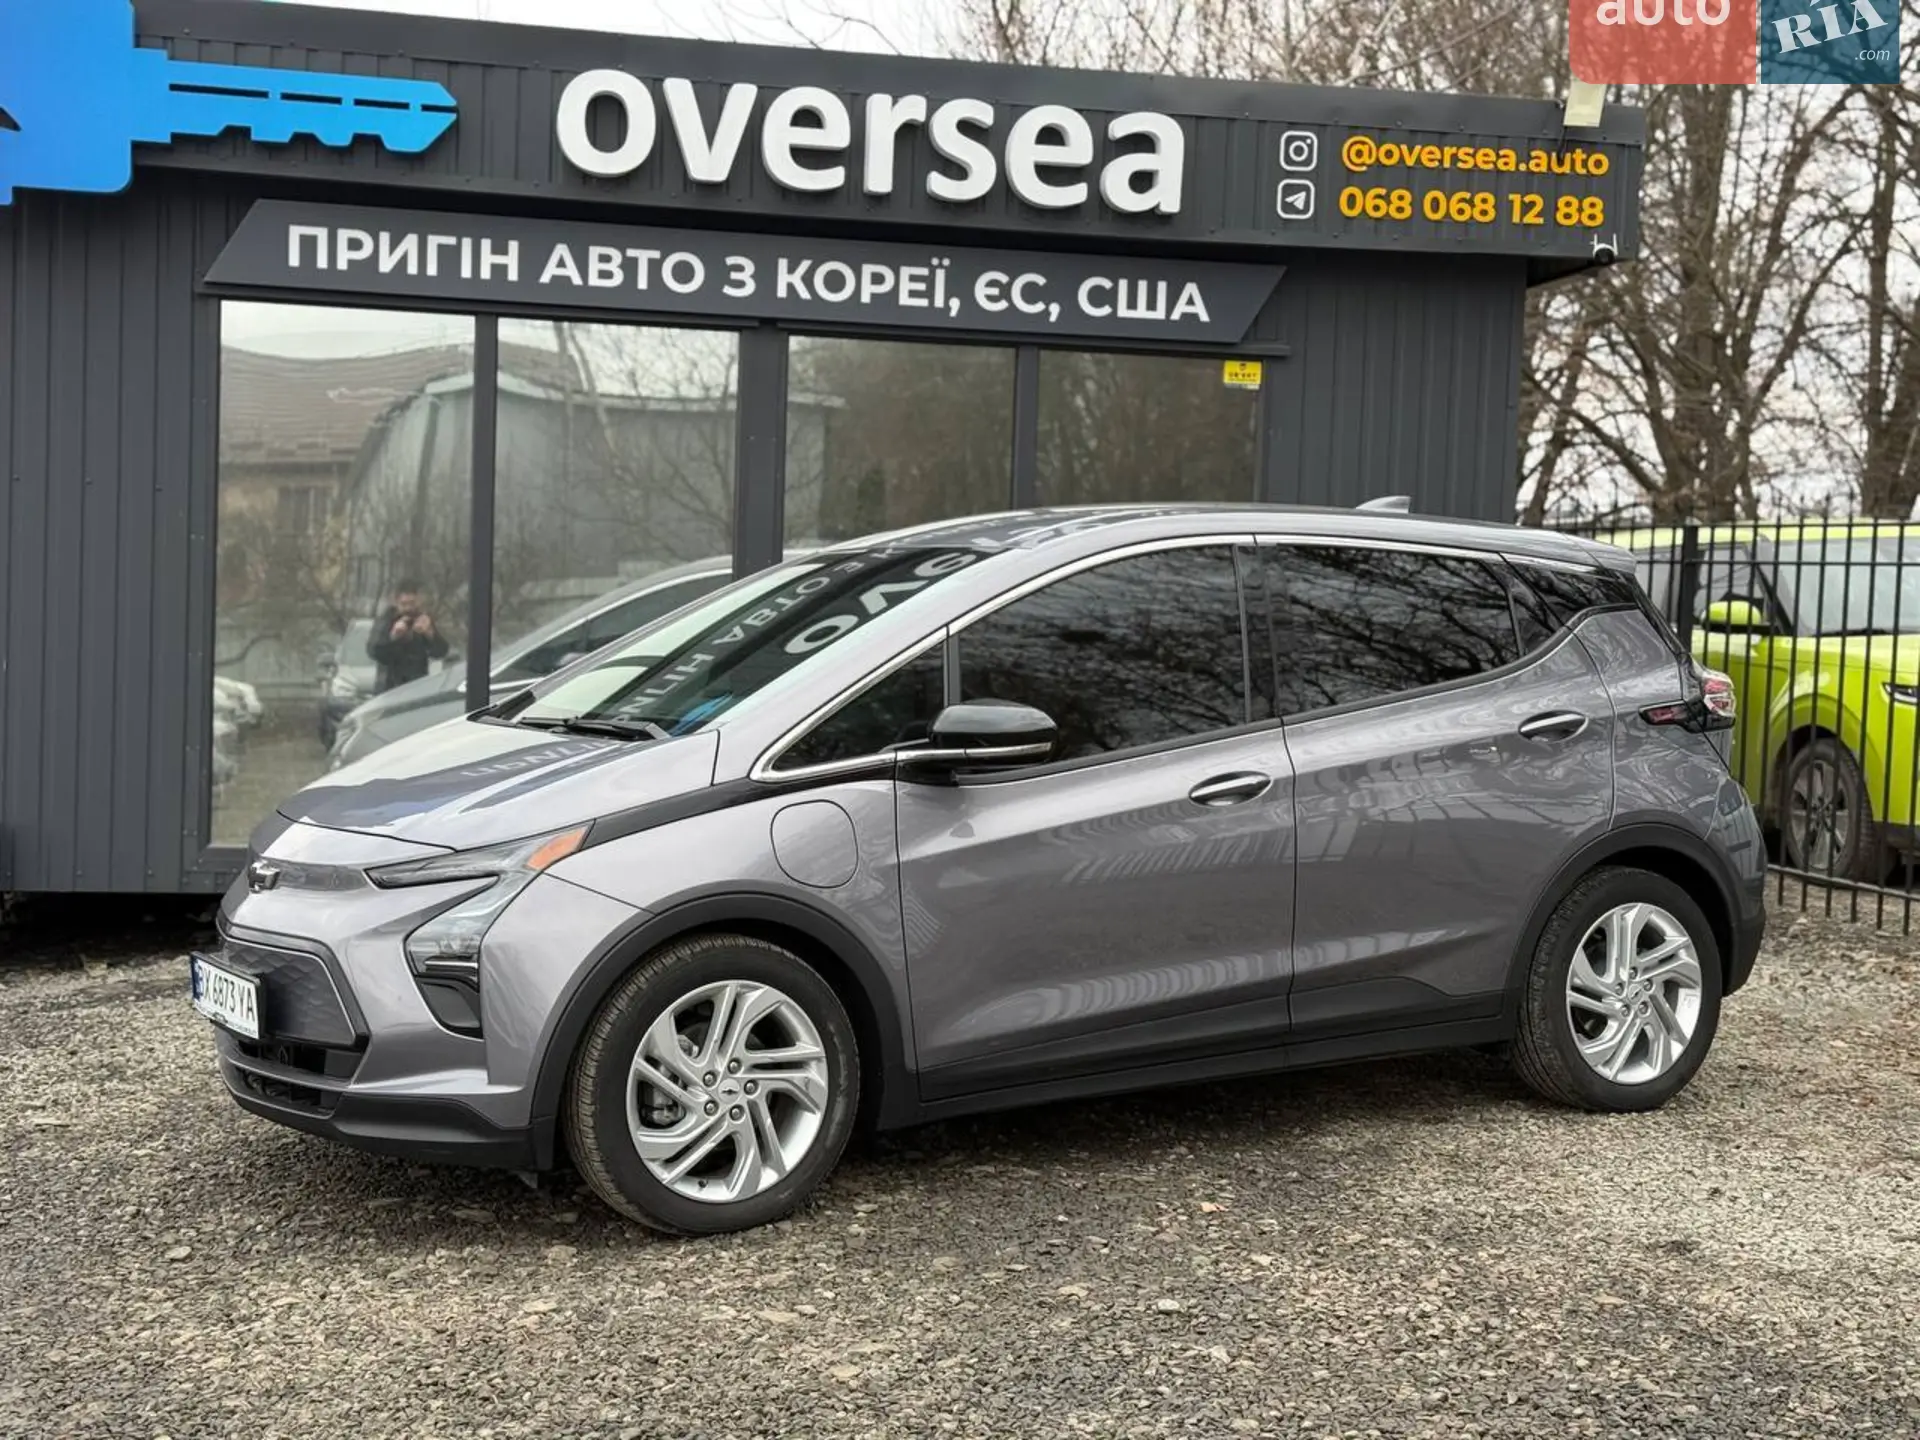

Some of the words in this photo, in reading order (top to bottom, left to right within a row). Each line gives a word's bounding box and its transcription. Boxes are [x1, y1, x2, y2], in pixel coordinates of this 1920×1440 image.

[556, 68, 1186, 216] oversea
[1341, 135, 1610, 176] @oversea.auto
[1339, 186, 1413, 220] 068
[1422, 190, 1496, 223] 068
[1508, 193, 1544, 224] 12
[1555, 195, 1604, 227] 88
[287, 225, 519, 281] ПРИГІН
[539, 243, 706, 294] АВТО
[721, 255, 757, 298] З
[776, 257, 961, 317] КОРЕЇ,
[974, 271, 1061, 322] ЄС,
[1077, 276, 1211, 322] США
[212, 972, 237, 1014] 6873
[237, 983, 256, 1022] YA
